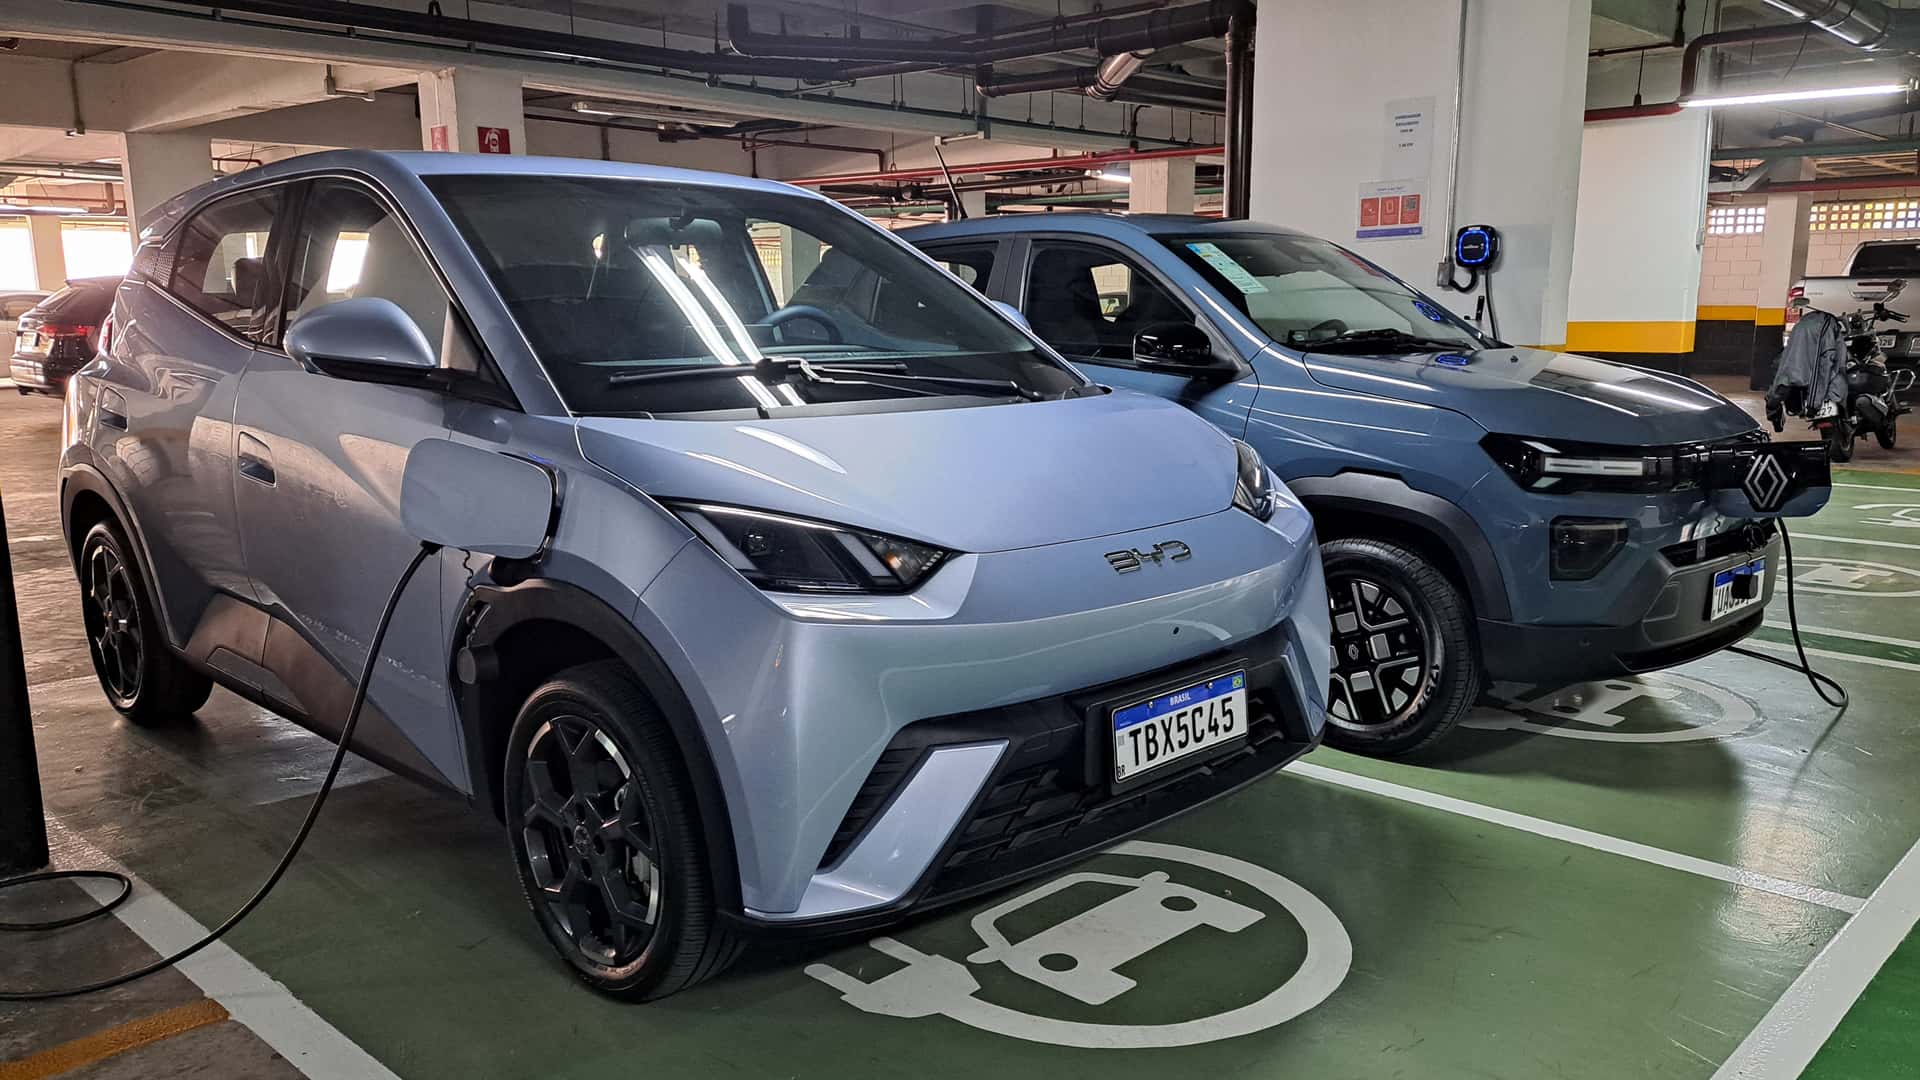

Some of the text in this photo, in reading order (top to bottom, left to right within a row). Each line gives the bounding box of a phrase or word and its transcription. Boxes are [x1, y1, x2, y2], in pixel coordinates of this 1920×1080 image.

[1104, 540, 1191, 574] BYD
[1169, 691, 1191, 706] BRASIL
[1129, 697, 1233, 767] TBX5C45
